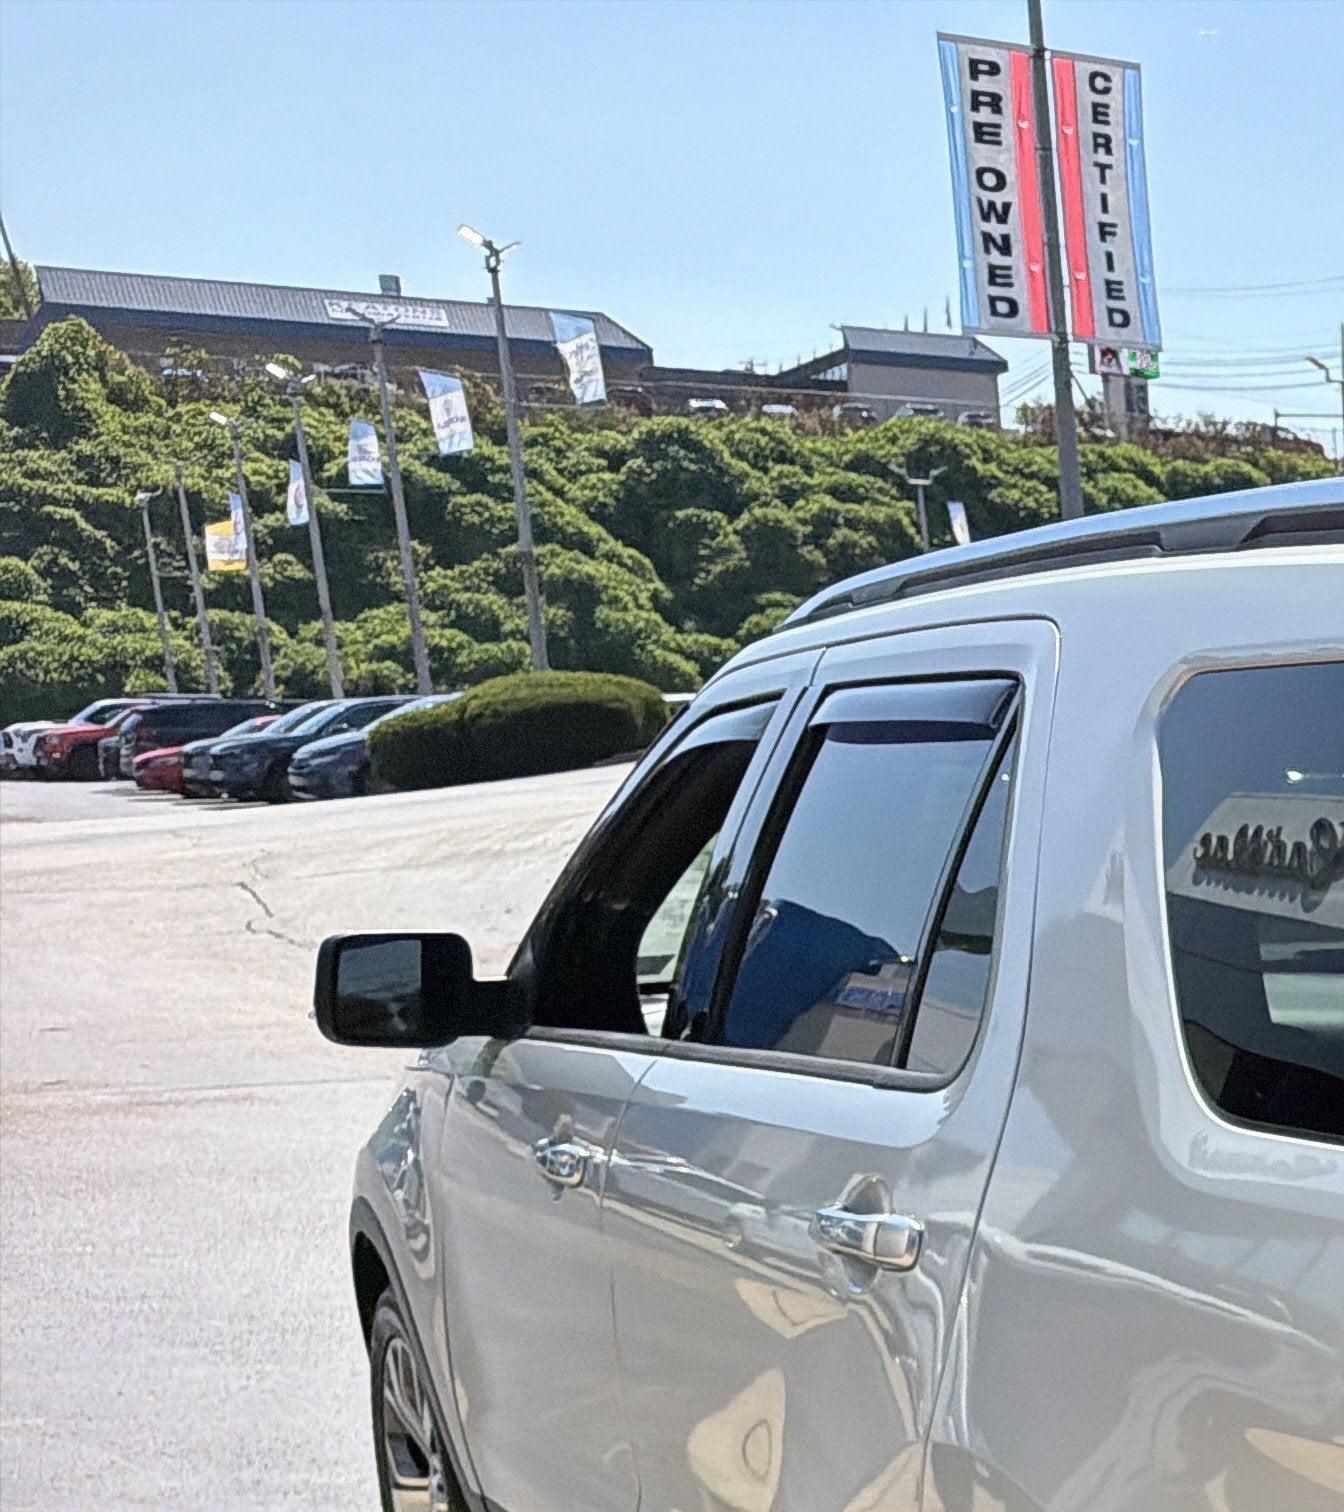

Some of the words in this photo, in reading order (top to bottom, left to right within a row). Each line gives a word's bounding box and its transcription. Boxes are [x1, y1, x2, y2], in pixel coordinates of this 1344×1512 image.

[967, 57, 1003, 147] PRE
[975, 166, 1020, 320] OWNED
[1088, 70, 1131, 329] CERTIFIED
